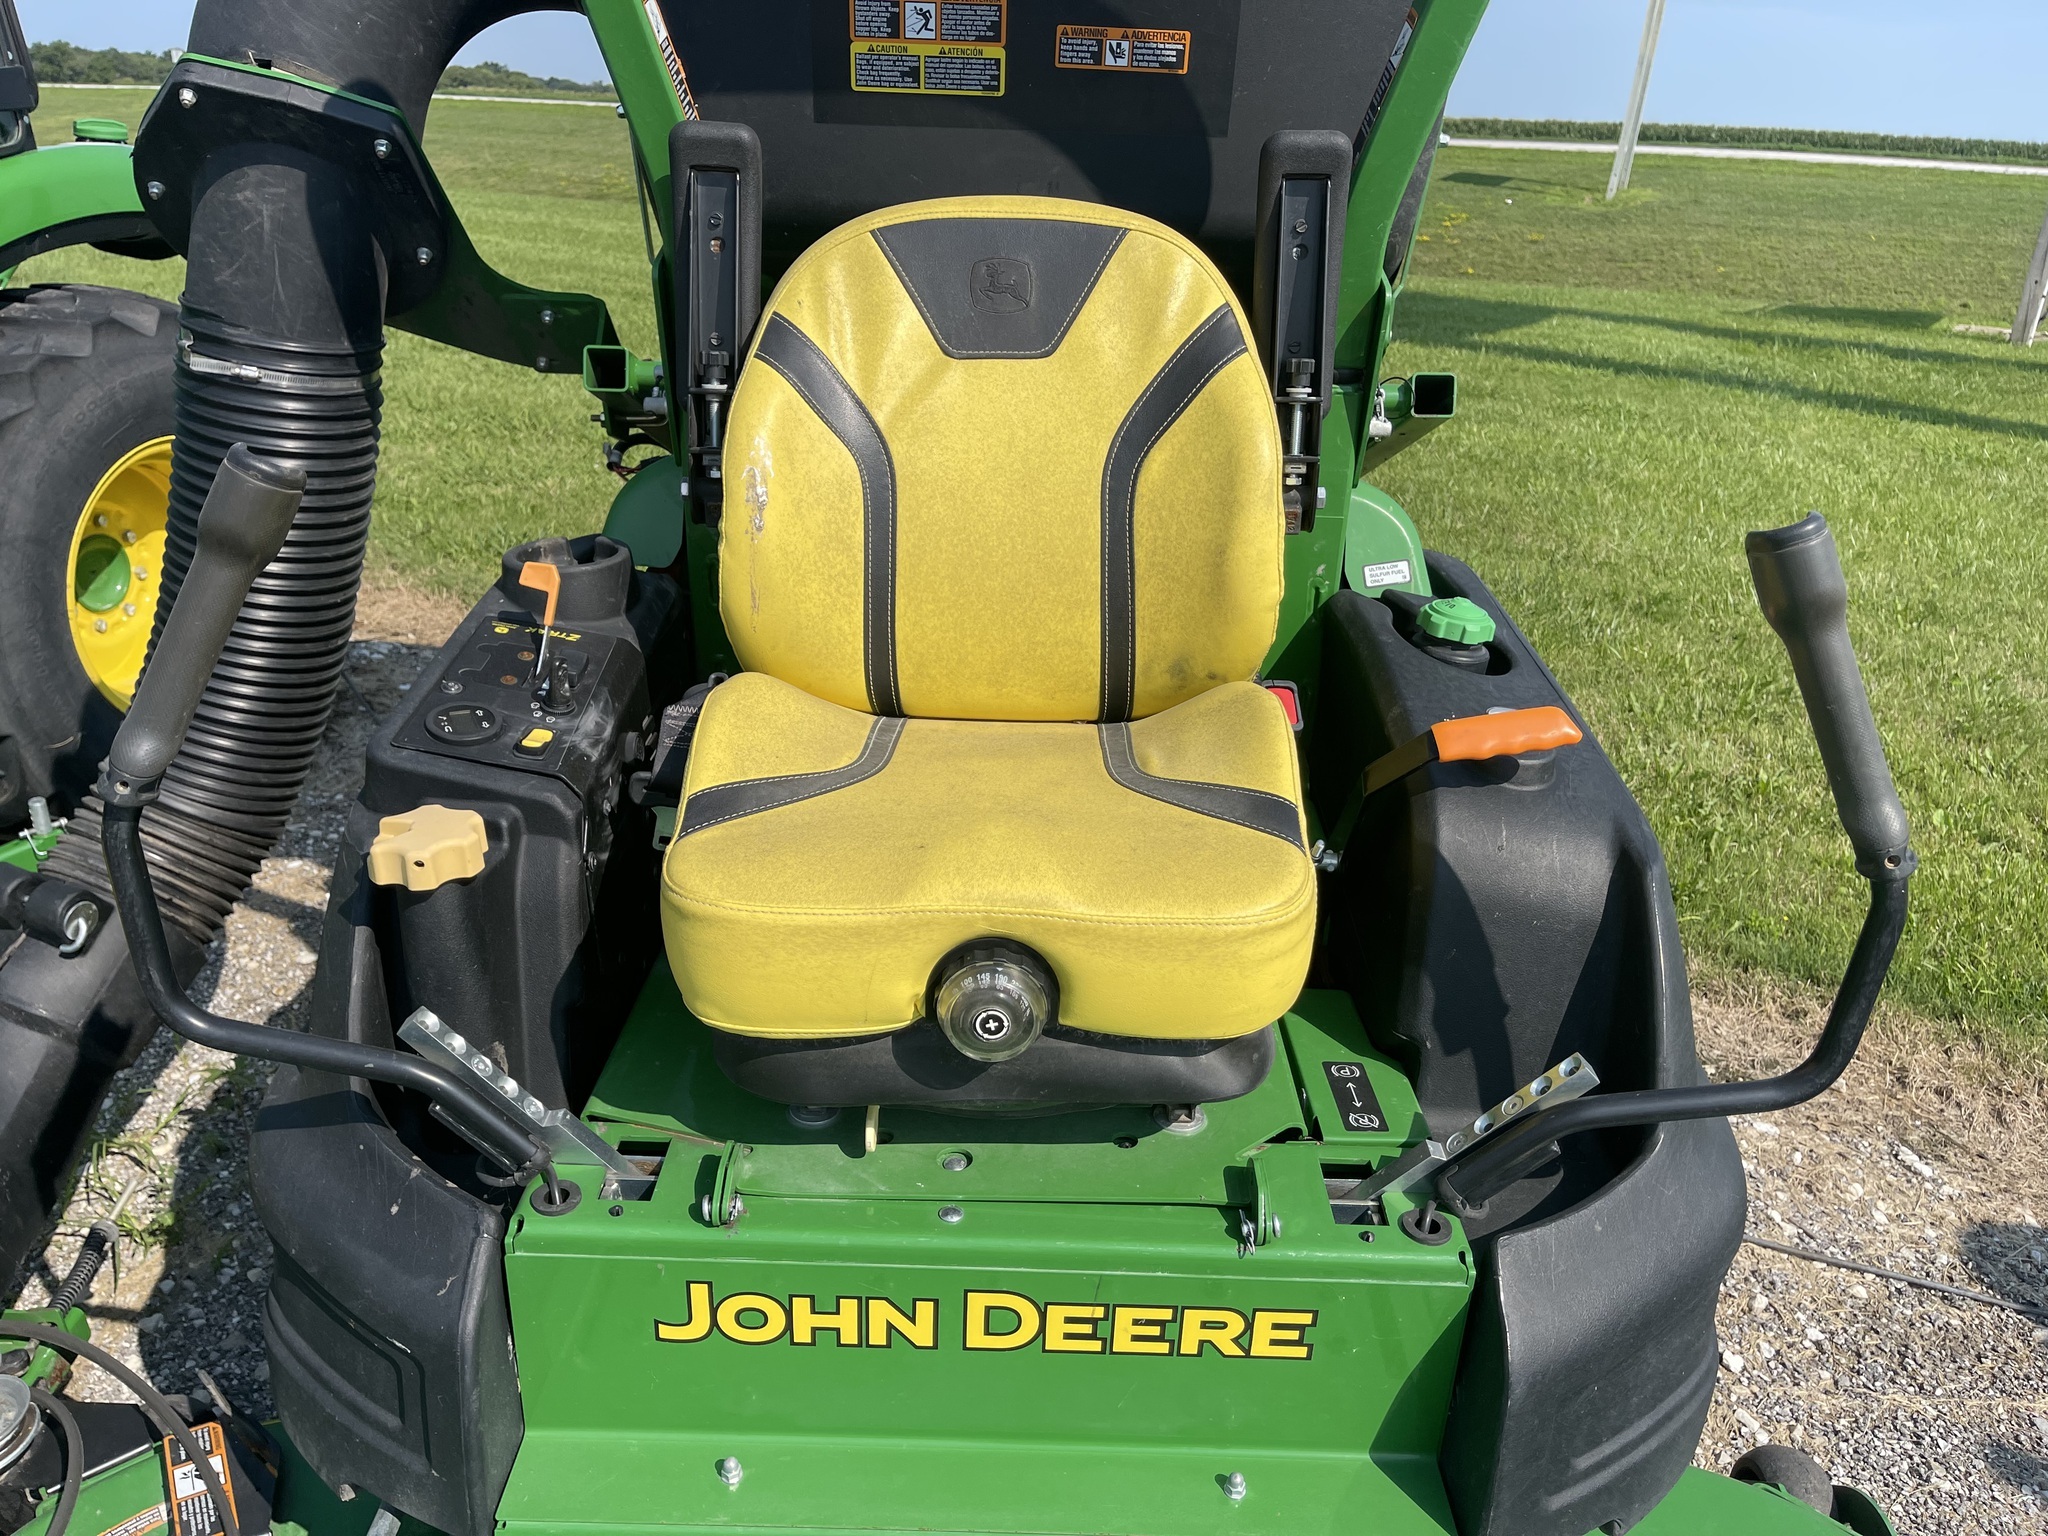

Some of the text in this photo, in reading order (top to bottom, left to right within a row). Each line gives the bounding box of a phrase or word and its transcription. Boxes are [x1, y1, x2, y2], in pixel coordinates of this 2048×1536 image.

[1070, 27, 1108, 38] WARNING
[1131, 30, 1186, 41] ADVERTENCIA
[876, 45, 908, 53] CAUTION
[947, 47, 983, 56] ATENCIÓN
[654, 1281, 1318, 1361] JOHN DEERE
